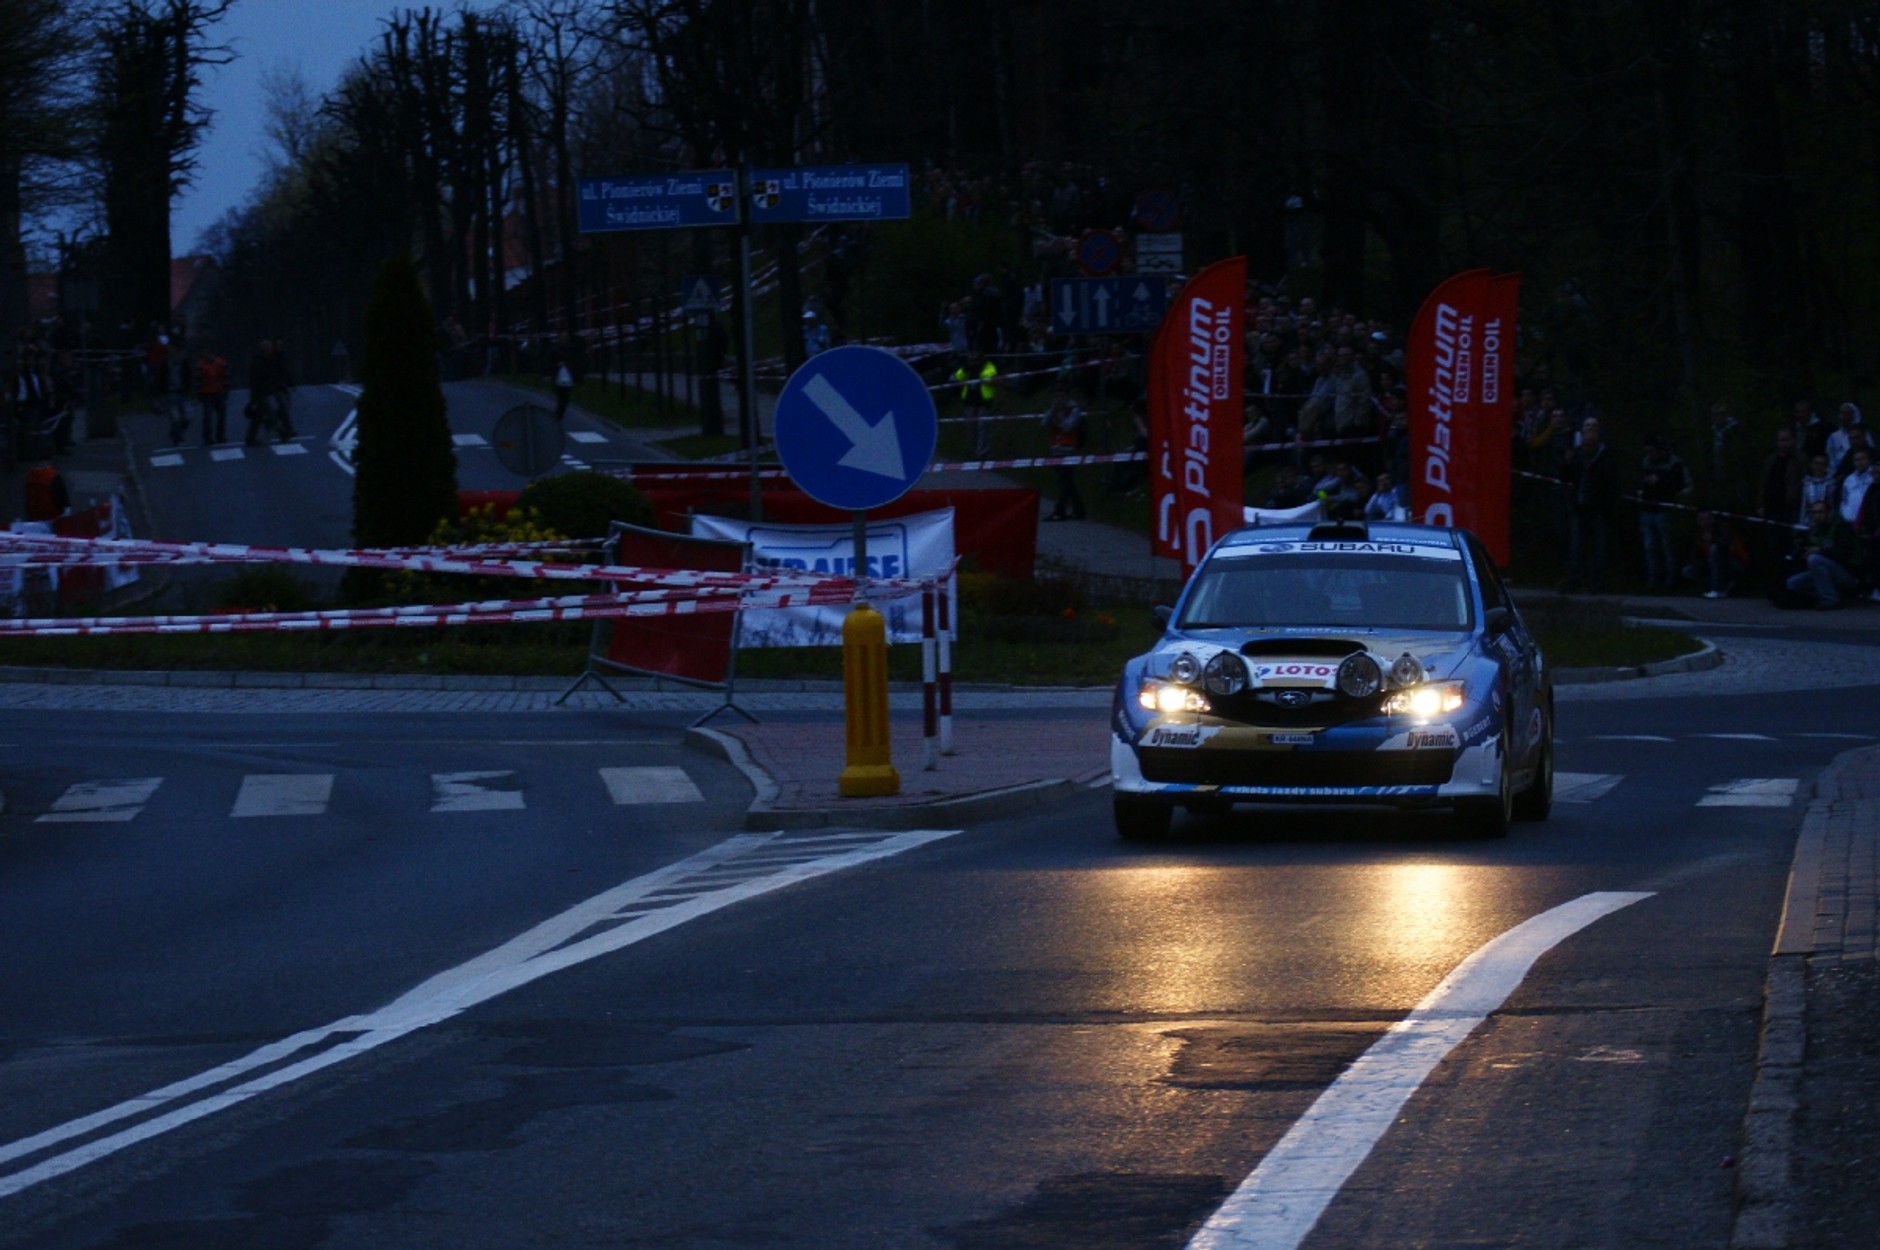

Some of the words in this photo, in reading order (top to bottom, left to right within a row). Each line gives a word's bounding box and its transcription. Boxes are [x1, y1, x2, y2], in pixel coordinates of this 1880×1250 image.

[600, 179, 664, 200] Pionierów
[666, 177, 704, 196] Ziemi
[801, 170, 866, 190] Pionierów
[867, 168, 905, 188] Ziemi
[605, 202, 681, 226] Świdnickiej
[807, 192, 882, 216] Świdnickiej
[1215, 305, 1231, 343] OIL
[1458, 314, 1473, 350] OIL
[1484, 317, 1501, 352] OIL
[1214, 346, 1228, 398] ORLEN
[1455, 351, 1470, 401] ORLEN
[1483, 353, 1497, 401] ORLEN
[1184, 297, 1213, 498] Platinum
[1425, 302, 1458, 494] Platinum
[1300, 542, 1415, 554] SUBARU
[1151, 728, 1200, 748] Dynamic
[1406, 731, 1456, 750] Dynamic
